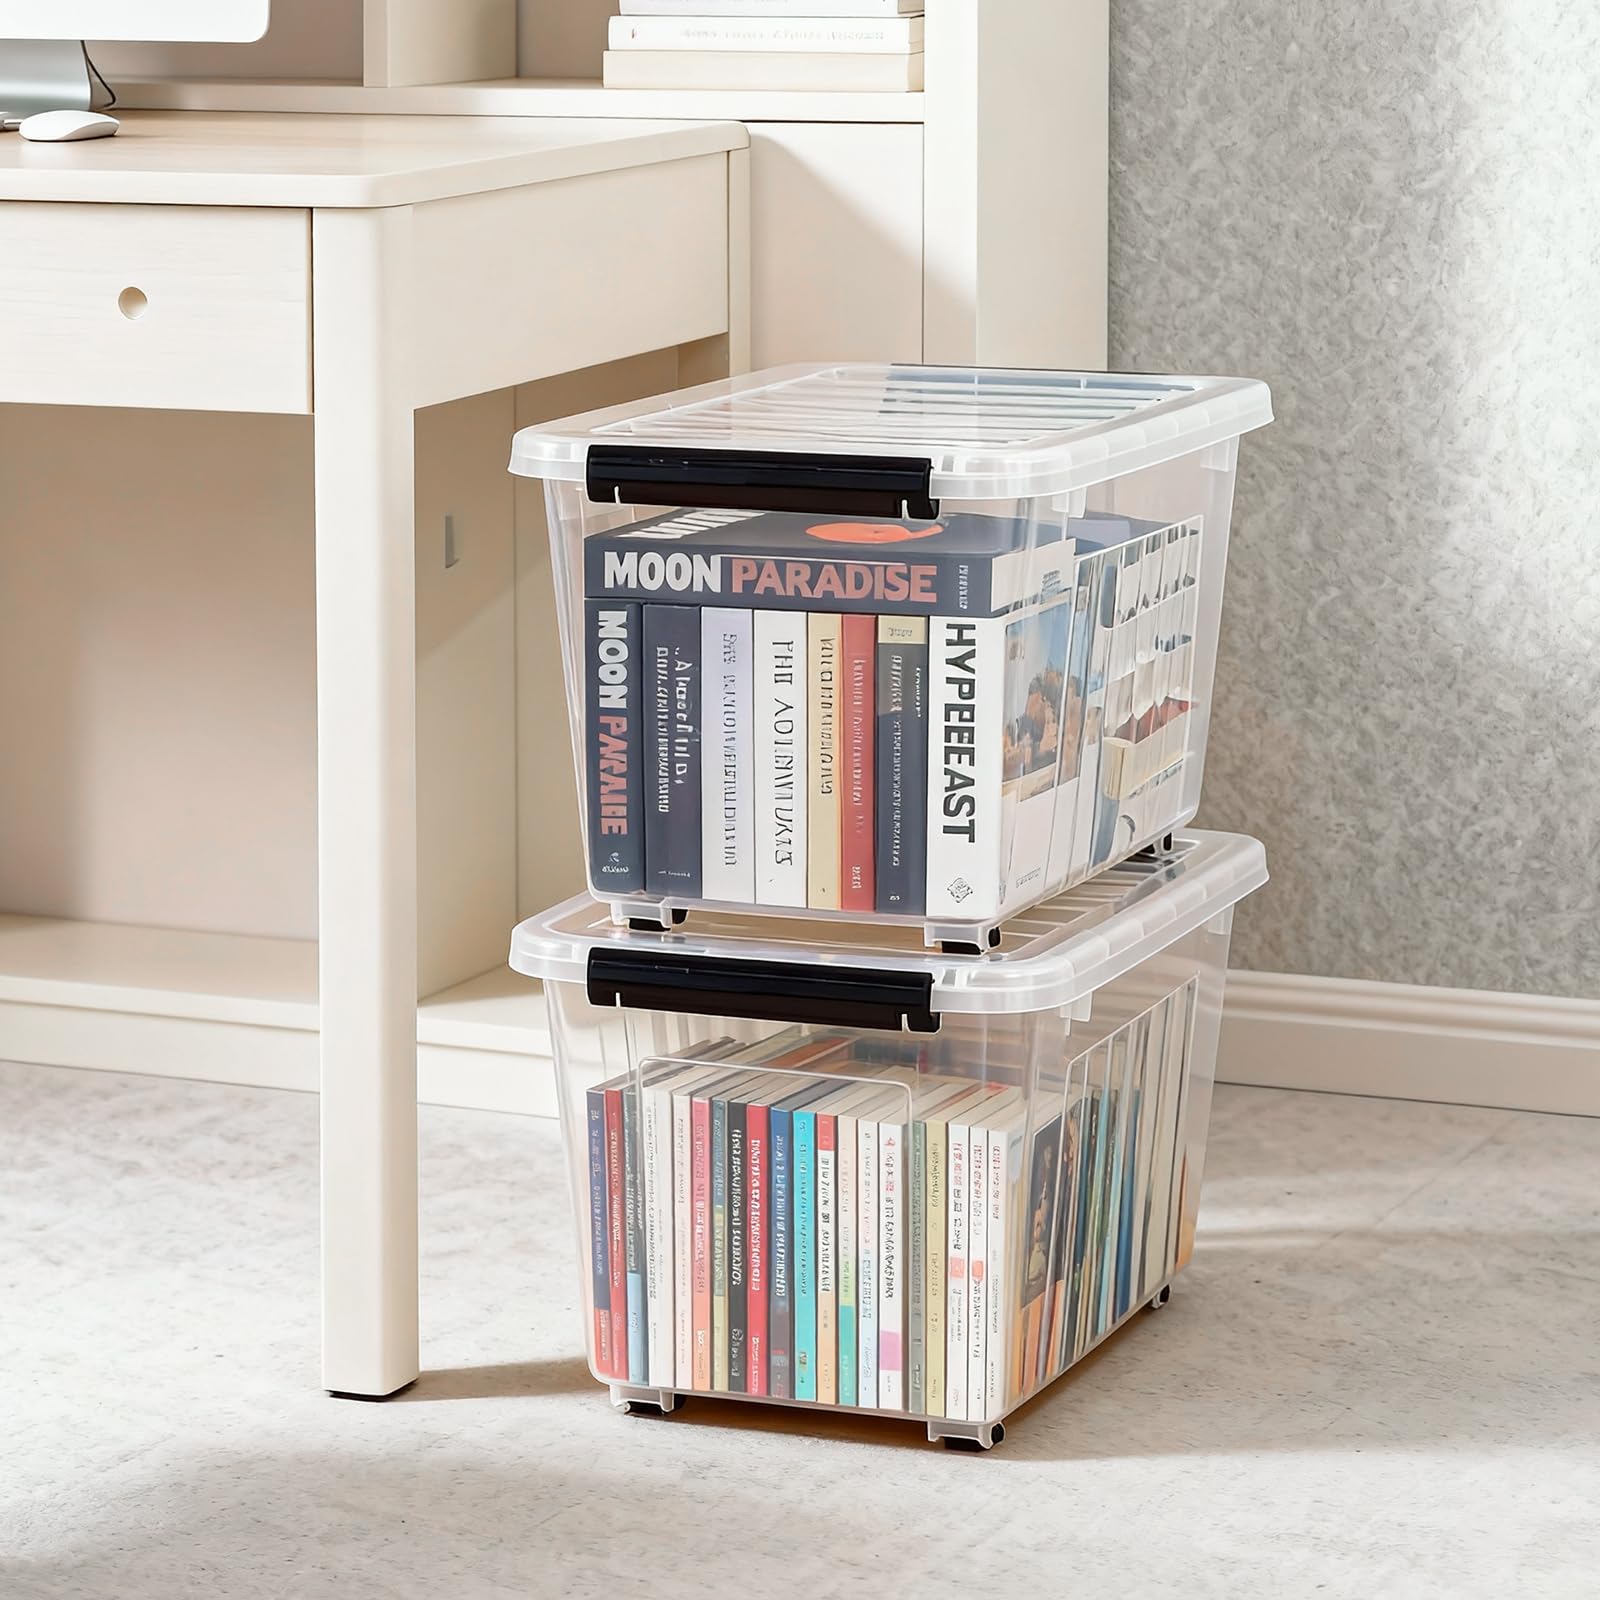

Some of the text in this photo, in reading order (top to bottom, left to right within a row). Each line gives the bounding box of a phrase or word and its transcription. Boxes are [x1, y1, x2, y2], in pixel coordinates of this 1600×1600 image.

[604, 551, 721, 593] MOON
[731, 559, 937, 603] PARADISE
[598, 611, 629, 709] MOON
